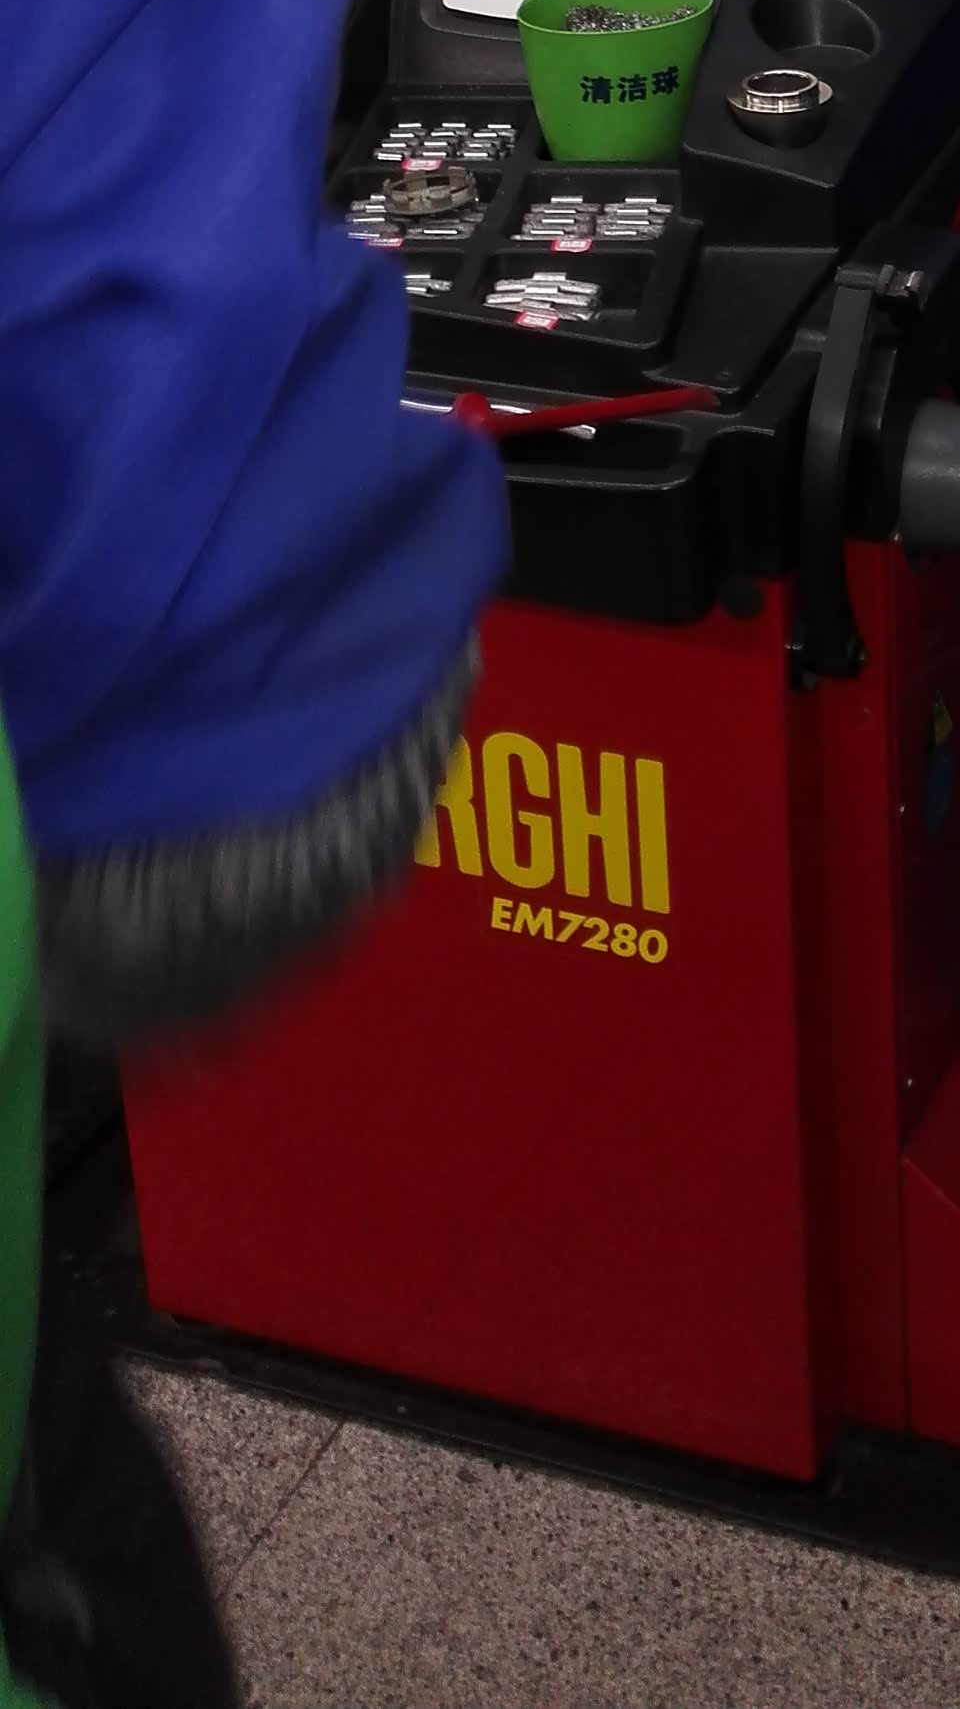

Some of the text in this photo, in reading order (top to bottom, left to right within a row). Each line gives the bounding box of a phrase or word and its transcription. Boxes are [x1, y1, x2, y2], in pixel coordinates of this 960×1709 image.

[580, 66, 680, 104] 清洁球
[491, 897, 669, 963] EM7280
